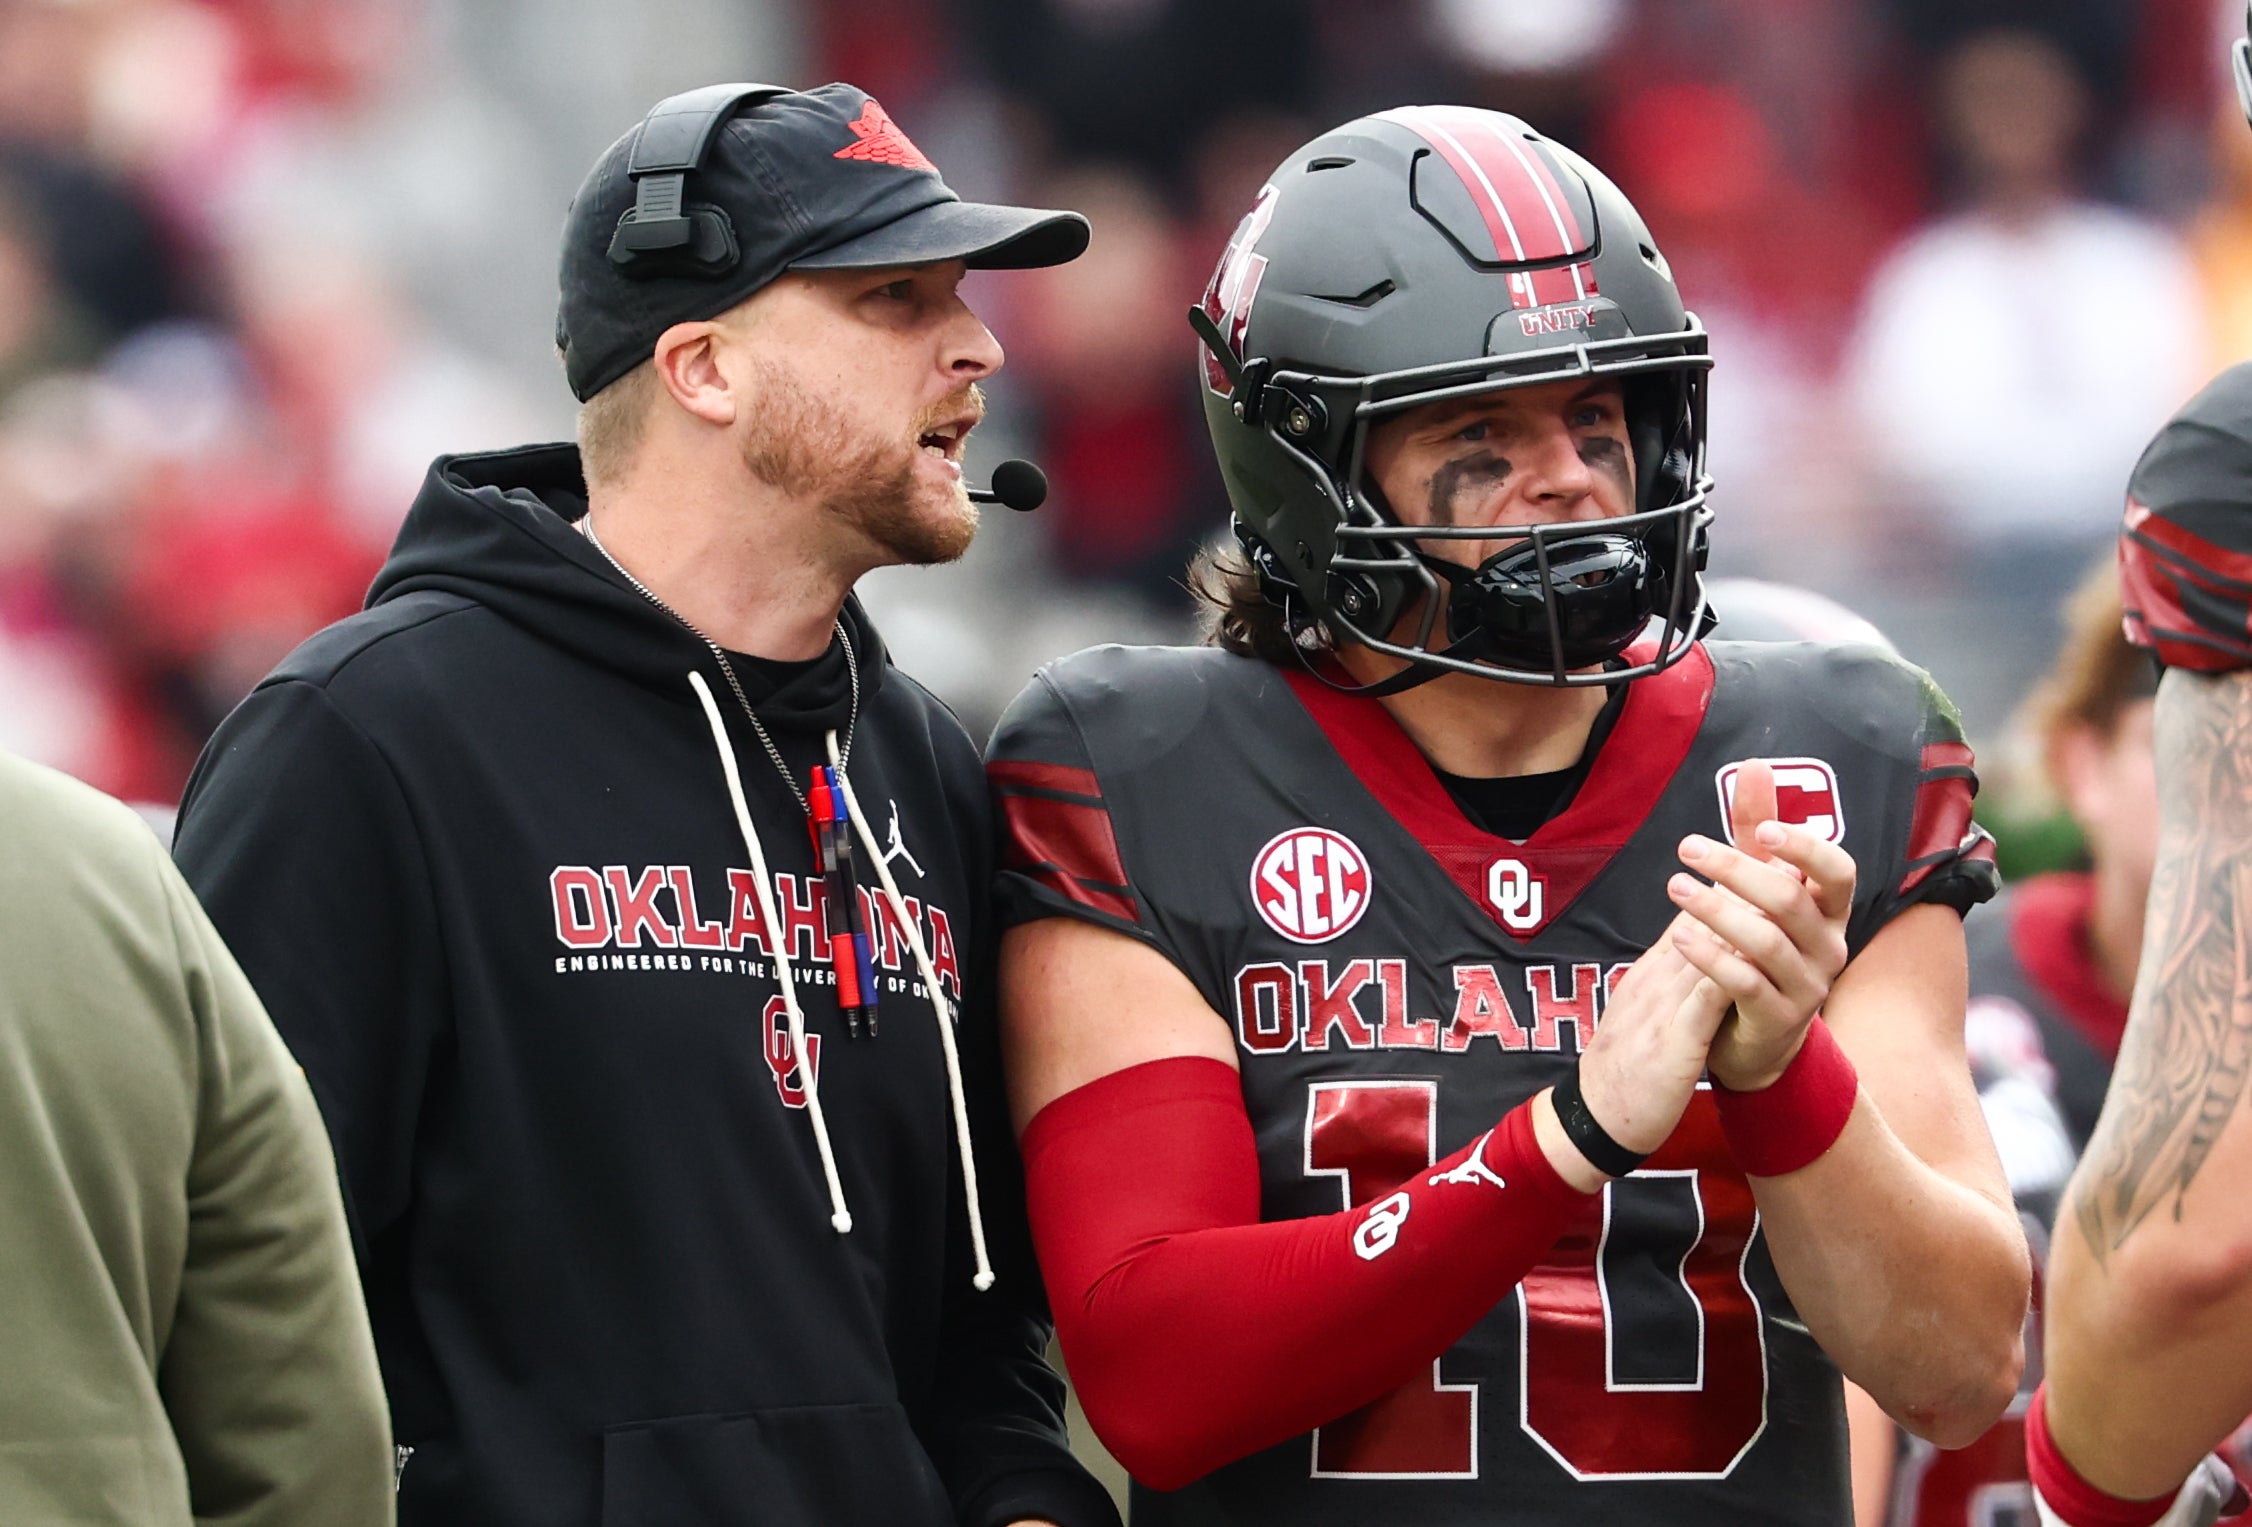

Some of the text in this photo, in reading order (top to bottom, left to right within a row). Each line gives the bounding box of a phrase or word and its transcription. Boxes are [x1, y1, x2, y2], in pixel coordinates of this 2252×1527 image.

[1518, 304, 1596, 336] UNITY
[1260, 829, 1362, 936] SEC
[1488, 858, 1546, 930] OU
[554, 954, 693, 974] ENGINEERED
[700, 956, 734, 973] FOR
[738, 959, 766, 979] THE
[887, 976, 908, 994] OF
[1233, 958, 1636, 1056] OKLAH
[761, 994, 822, 1109] OU
[1352, 1191, 1411, 1261] OU
[1303, 1080, 1769, 1482] 10
